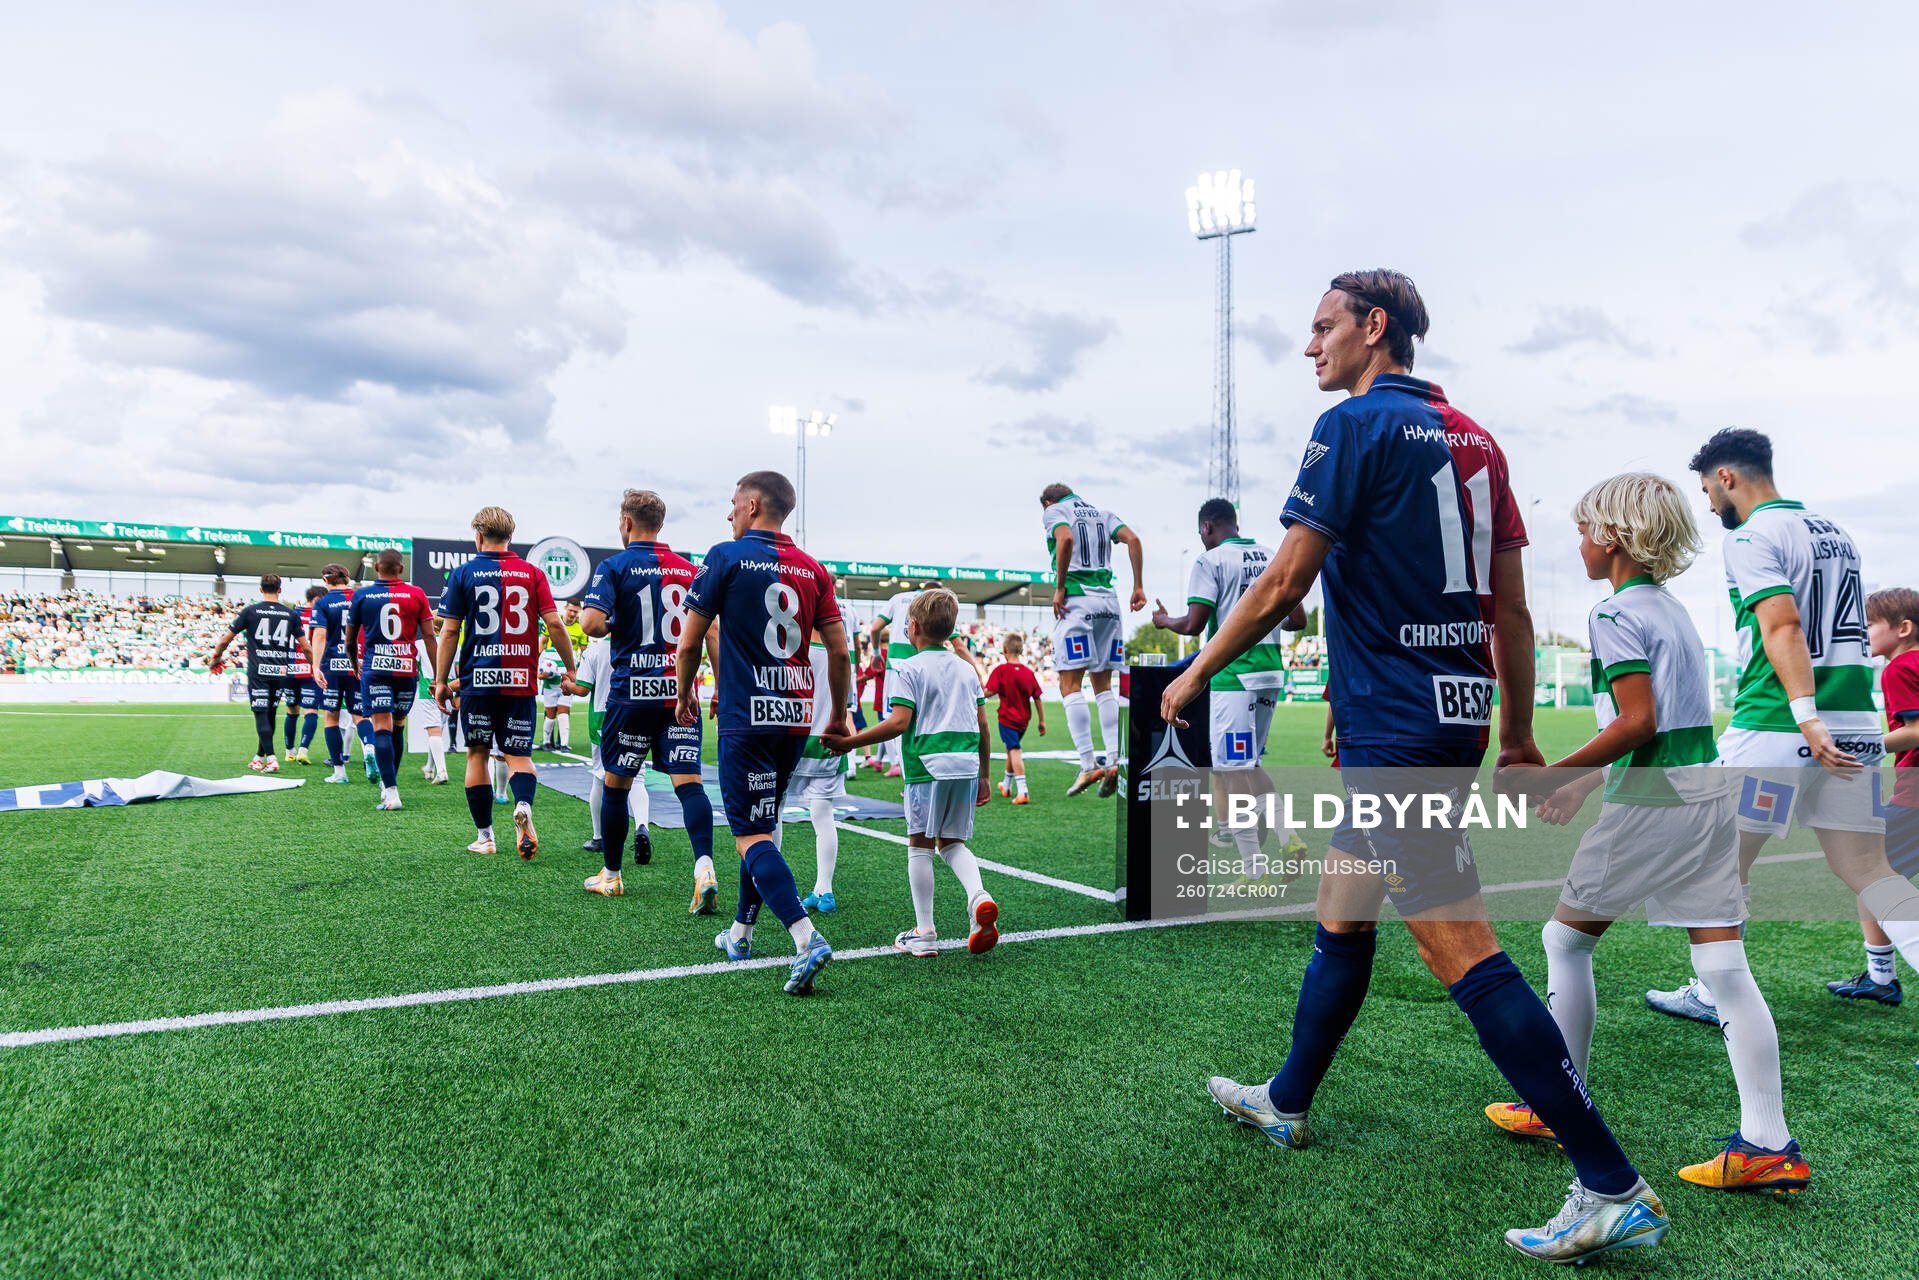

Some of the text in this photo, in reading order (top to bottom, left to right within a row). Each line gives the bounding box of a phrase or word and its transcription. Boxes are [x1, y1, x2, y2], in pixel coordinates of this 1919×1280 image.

[1403, 424, 1493, 453] HAMMARVIKEN
[26, 520, 80, 534] Telexia
[117, 526, 168, 539] Telexia
[1431, 461, 1493, 595] 11
[203, 531, 252, 544] Telexia
[283, 534, 329, 547] Telexia
[359, 538, 403, 550] Telexia
[1078, 522, 1107, 568] 11
[473, 570, 530, 579] HAMMARVIKEN
[630, 567, 692, 577] HAMMARVIKEN
[740, 560, 815, 579] HAMMARVIKEN
[475, 585, 529, 635] 33
[636, 583, 689, 646] 18
[1807, 568, 1869, 659] 14
[380, 603, 403, 640] 6
[764, 582, 802, 659] 8
[255, 618, 289, 647] 44
[473, 643, 531, 657] LAGERLUND
[260, 665, 280, 674] BESAB
[373, 657, 402, 670] BESAB
[475, 670, 512, 685] BESAB
[753, 665, 813, 691] LATURNUS
[633, 679, 677, 697] BESAB
[754, 700, 804, 723] BESAB
[668, 745, 700, 763] NTEX
[1137, 778, 1201, 801] SELECT
[1561, 1058, 1593, 1110] umbro
